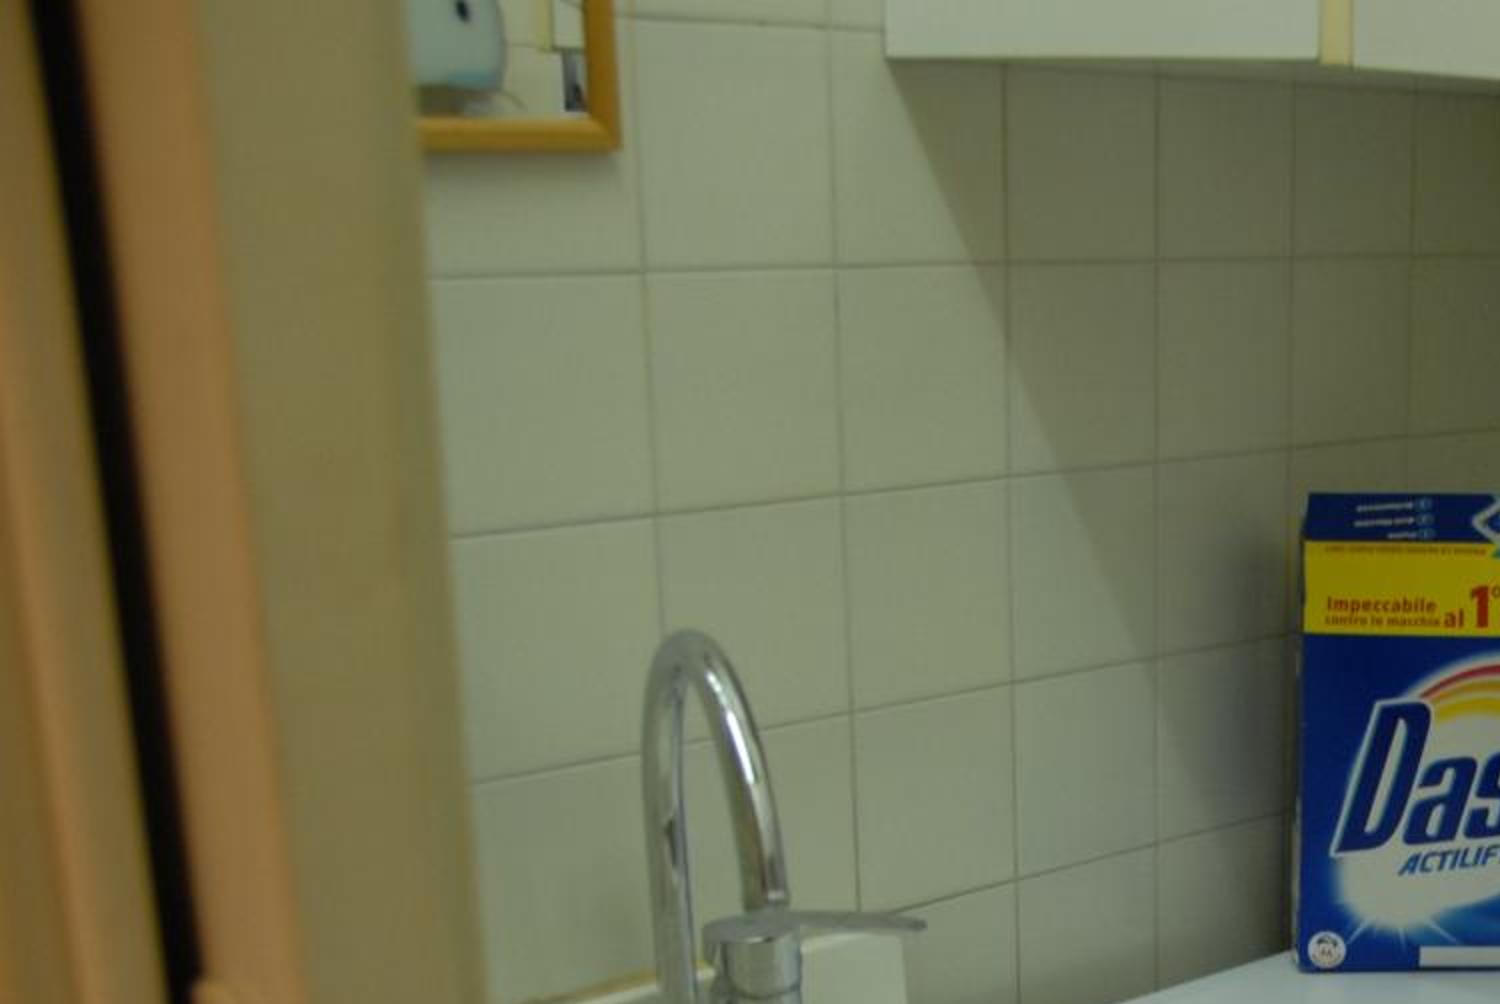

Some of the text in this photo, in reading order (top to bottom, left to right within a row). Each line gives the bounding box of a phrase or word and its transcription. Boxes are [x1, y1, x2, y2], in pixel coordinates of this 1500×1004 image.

[1327, 595, 1439, 614] Impeccabile
[1325, 614, 1368, 626] contro
[1444, 608, 1464, 629] al
